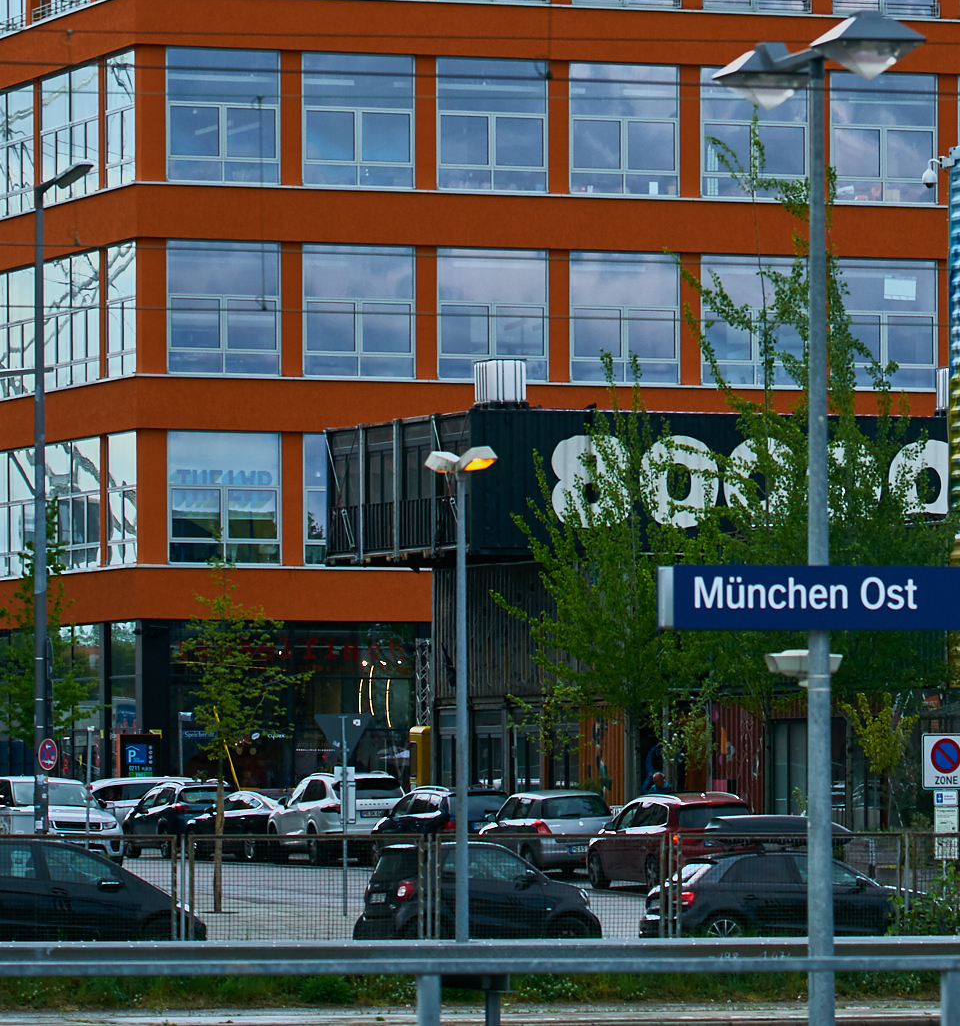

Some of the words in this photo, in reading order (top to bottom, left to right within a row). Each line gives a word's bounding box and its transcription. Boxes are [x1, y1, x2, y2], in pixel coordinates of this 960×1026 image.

[693, 576, 848, 610] München
[860, 576, 918, 610] Ost
[934, 775, 958, 785] ZONE
